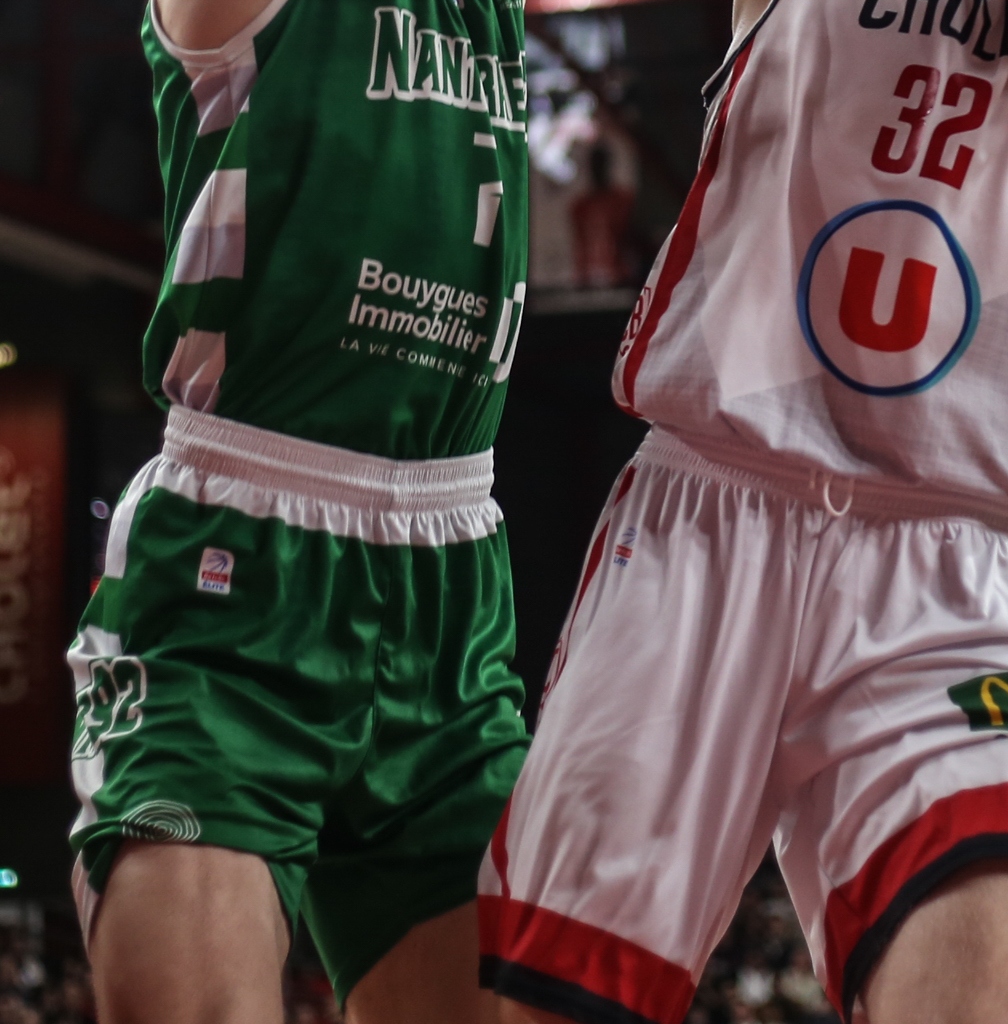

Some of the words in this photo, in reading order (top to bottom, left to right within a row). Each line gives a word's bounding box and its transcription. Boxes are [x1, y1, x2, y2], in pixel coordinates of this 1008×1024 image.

[871, 63, 993, 191] 32
[357, 257, 489, 318] Bouygues
[838, 246, 938, 353] U
[348, 293, 488, 356] Immobilier
[340, 337, 360, 352] LA
[472, 373, 489, 387] ICI
